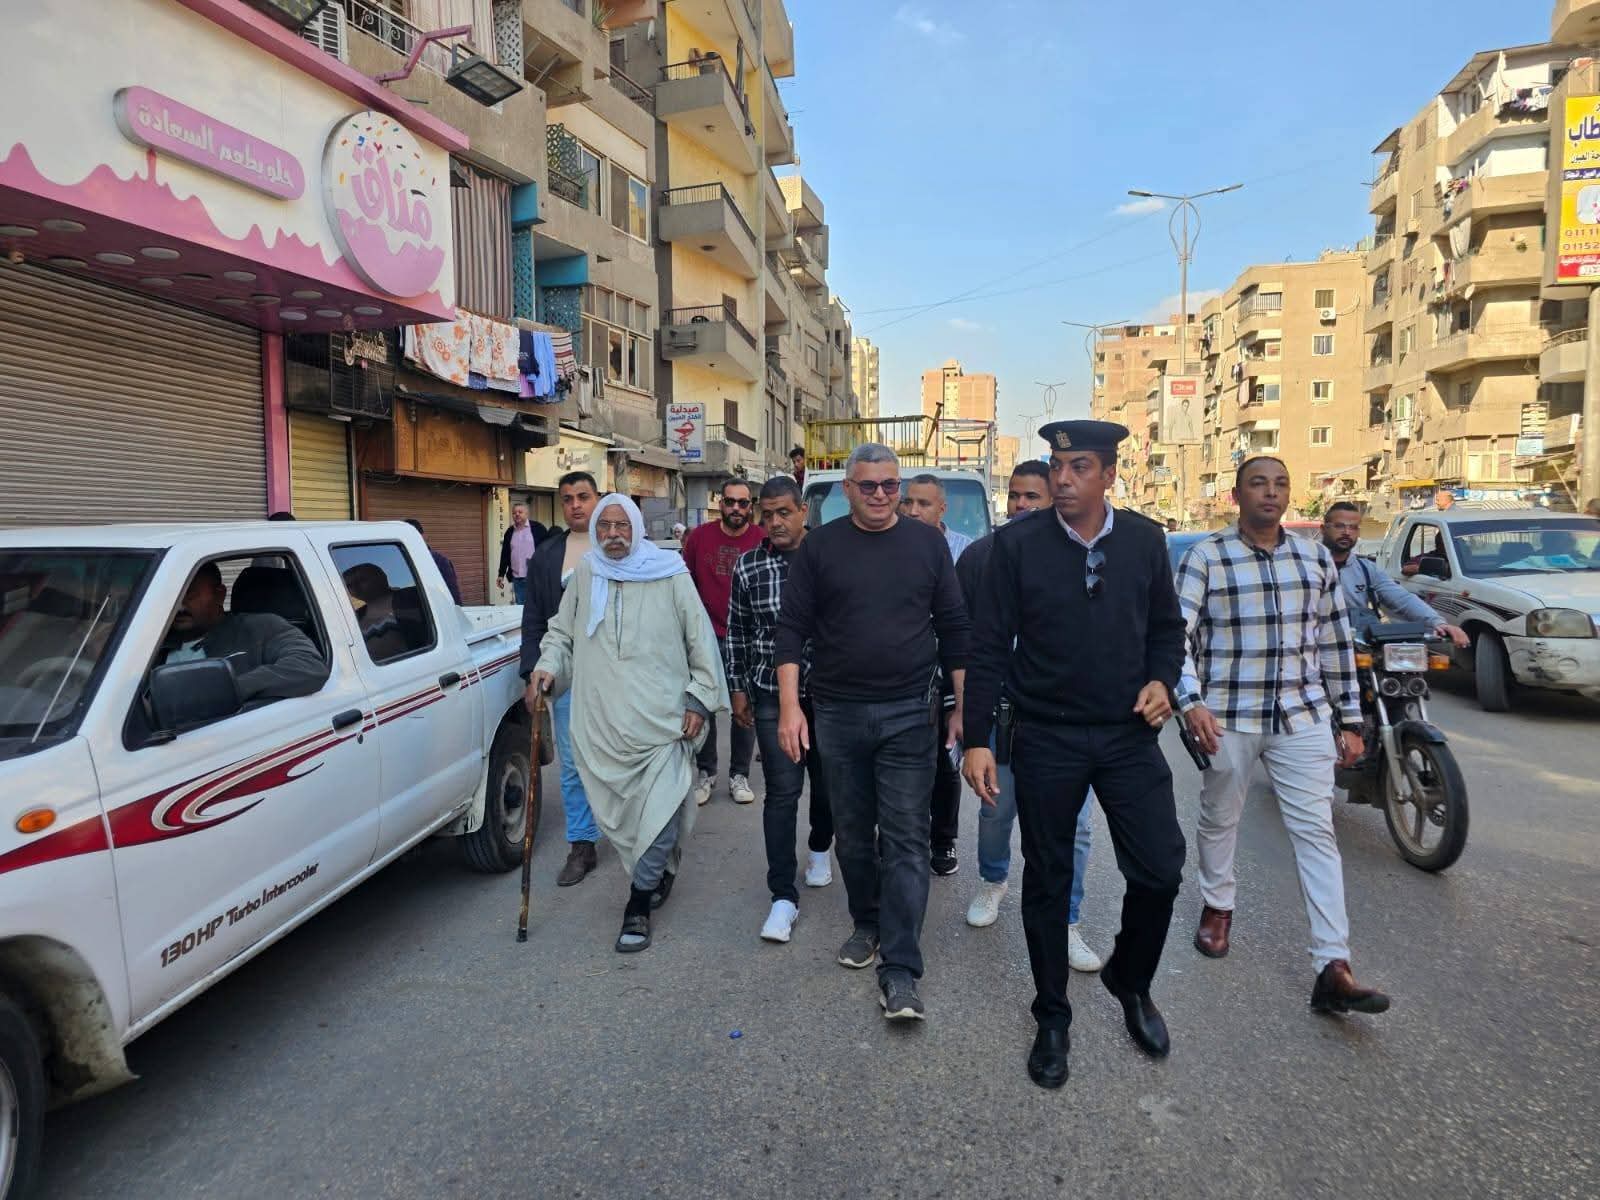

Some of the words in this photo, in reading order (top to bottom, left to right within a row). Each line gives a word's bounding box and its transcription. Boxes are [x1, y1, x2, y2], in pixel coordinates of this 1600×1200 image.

[138, 103, 214, 154] السعادة
[219, 142, 265, 181] بطعم
[267, 157, 296, 189] حلو
[670, 404, 699, 415] صيدلية
[159, 932, 196, 969] 130
[196, 914, 225, 946] HP
[226, 897, 262, 927] Turbo
[261, 862, 320, 906] Intercooler
